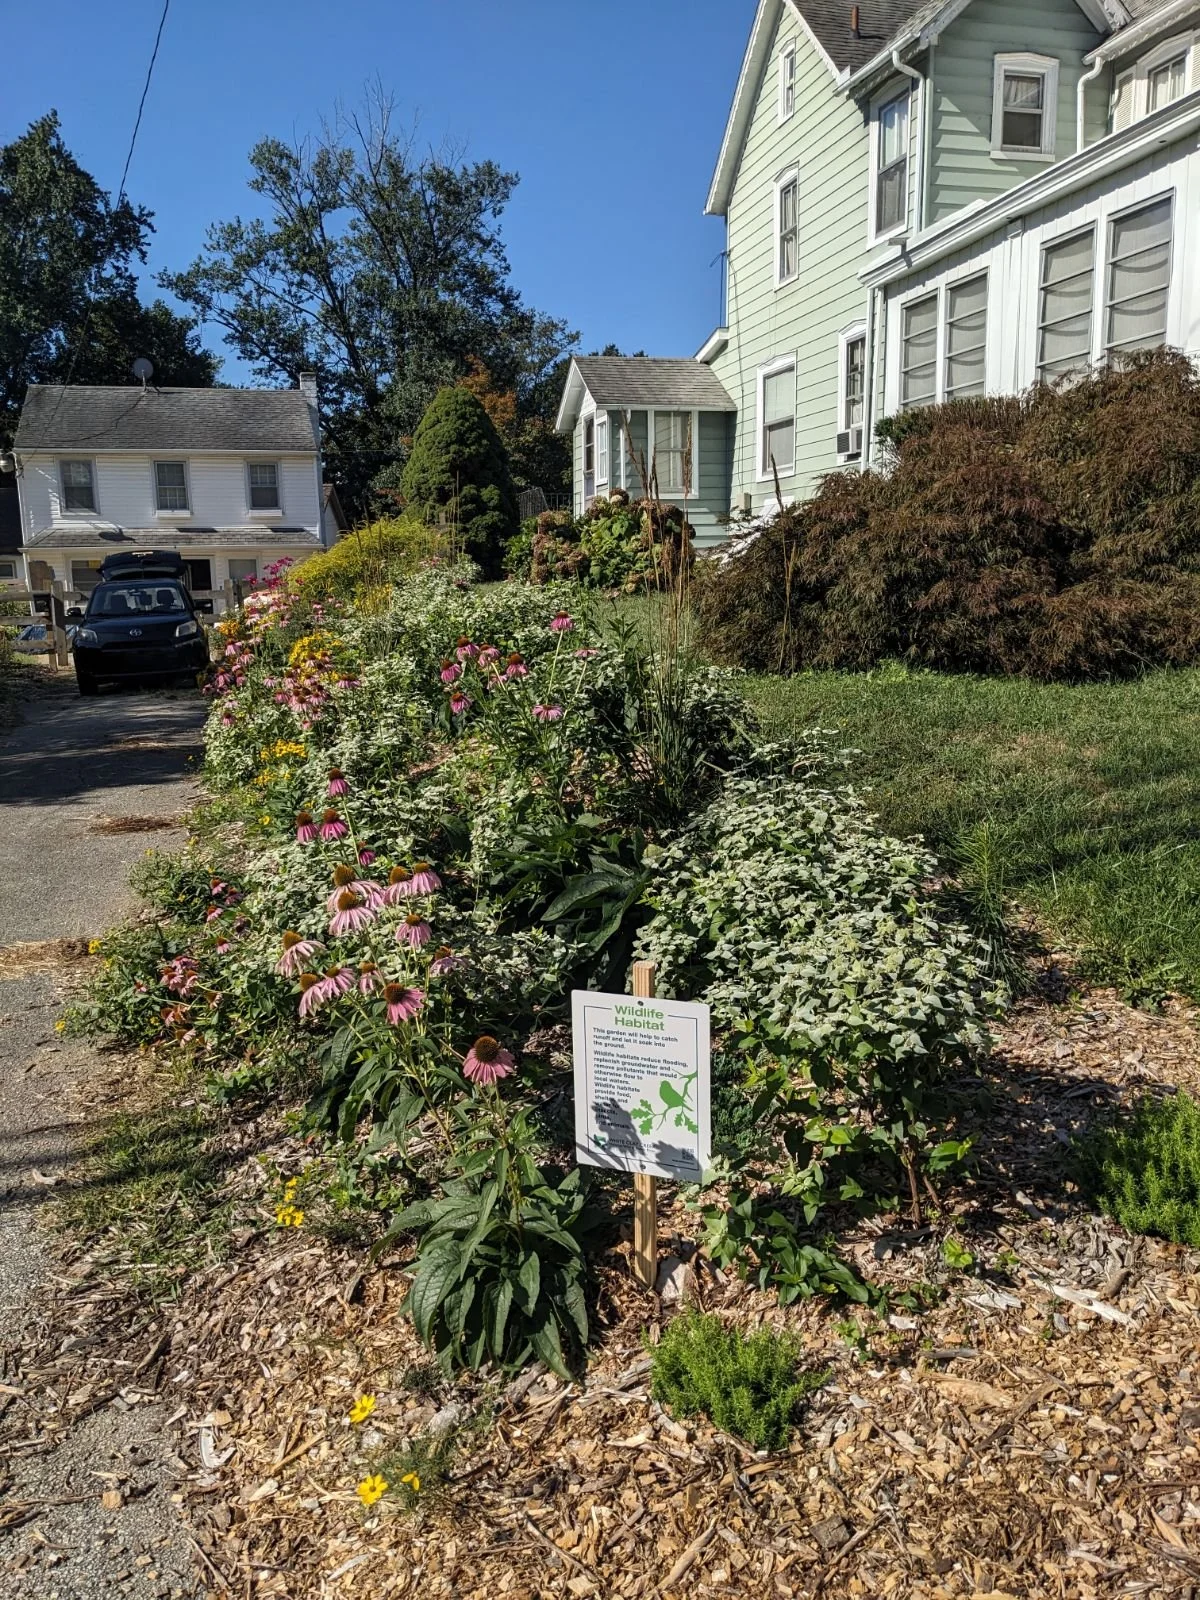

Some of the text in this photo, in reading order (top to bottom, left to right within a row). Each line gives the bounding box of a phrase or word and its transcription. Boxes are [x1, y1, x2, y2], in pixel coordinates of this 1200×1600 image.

[614, 1005, 664, 1019] Wildlife
[614, 1016, 665, 1031] Habitat
[616, 1052, 640, 1060] habitats
[594, 1057, 620, 1065] replenish
[621, 1060, 658, 1069] groundwater
[616, 1066, 645, 1074] pollutants
